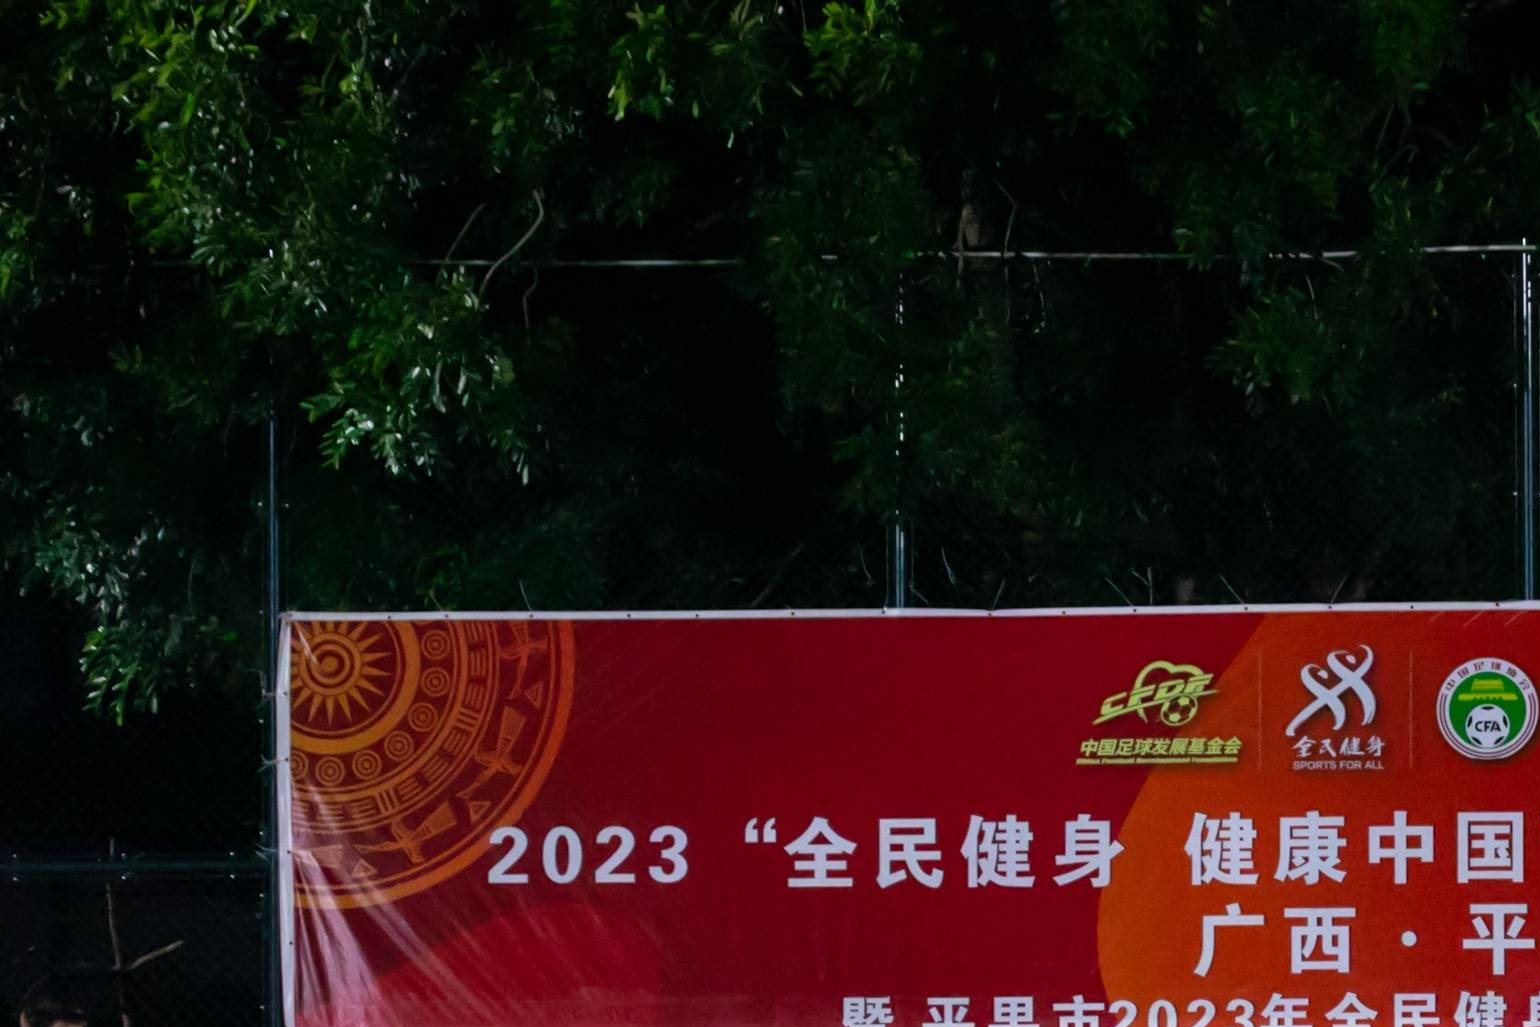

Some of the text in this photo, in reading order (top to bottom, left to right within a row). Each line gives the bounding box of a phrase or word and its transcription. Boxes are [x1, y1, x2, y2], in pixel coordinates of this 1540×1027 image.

[1475, 720, 1502, 732] CFA
[1080, 736, 1242, 757] 中国足球发展基金会
[1292, 735, 1386, 758] 全民健身
[1293, 760, 1385, 770] SPORTS FOR ALL
[488, 825, 688, 884] 2023
